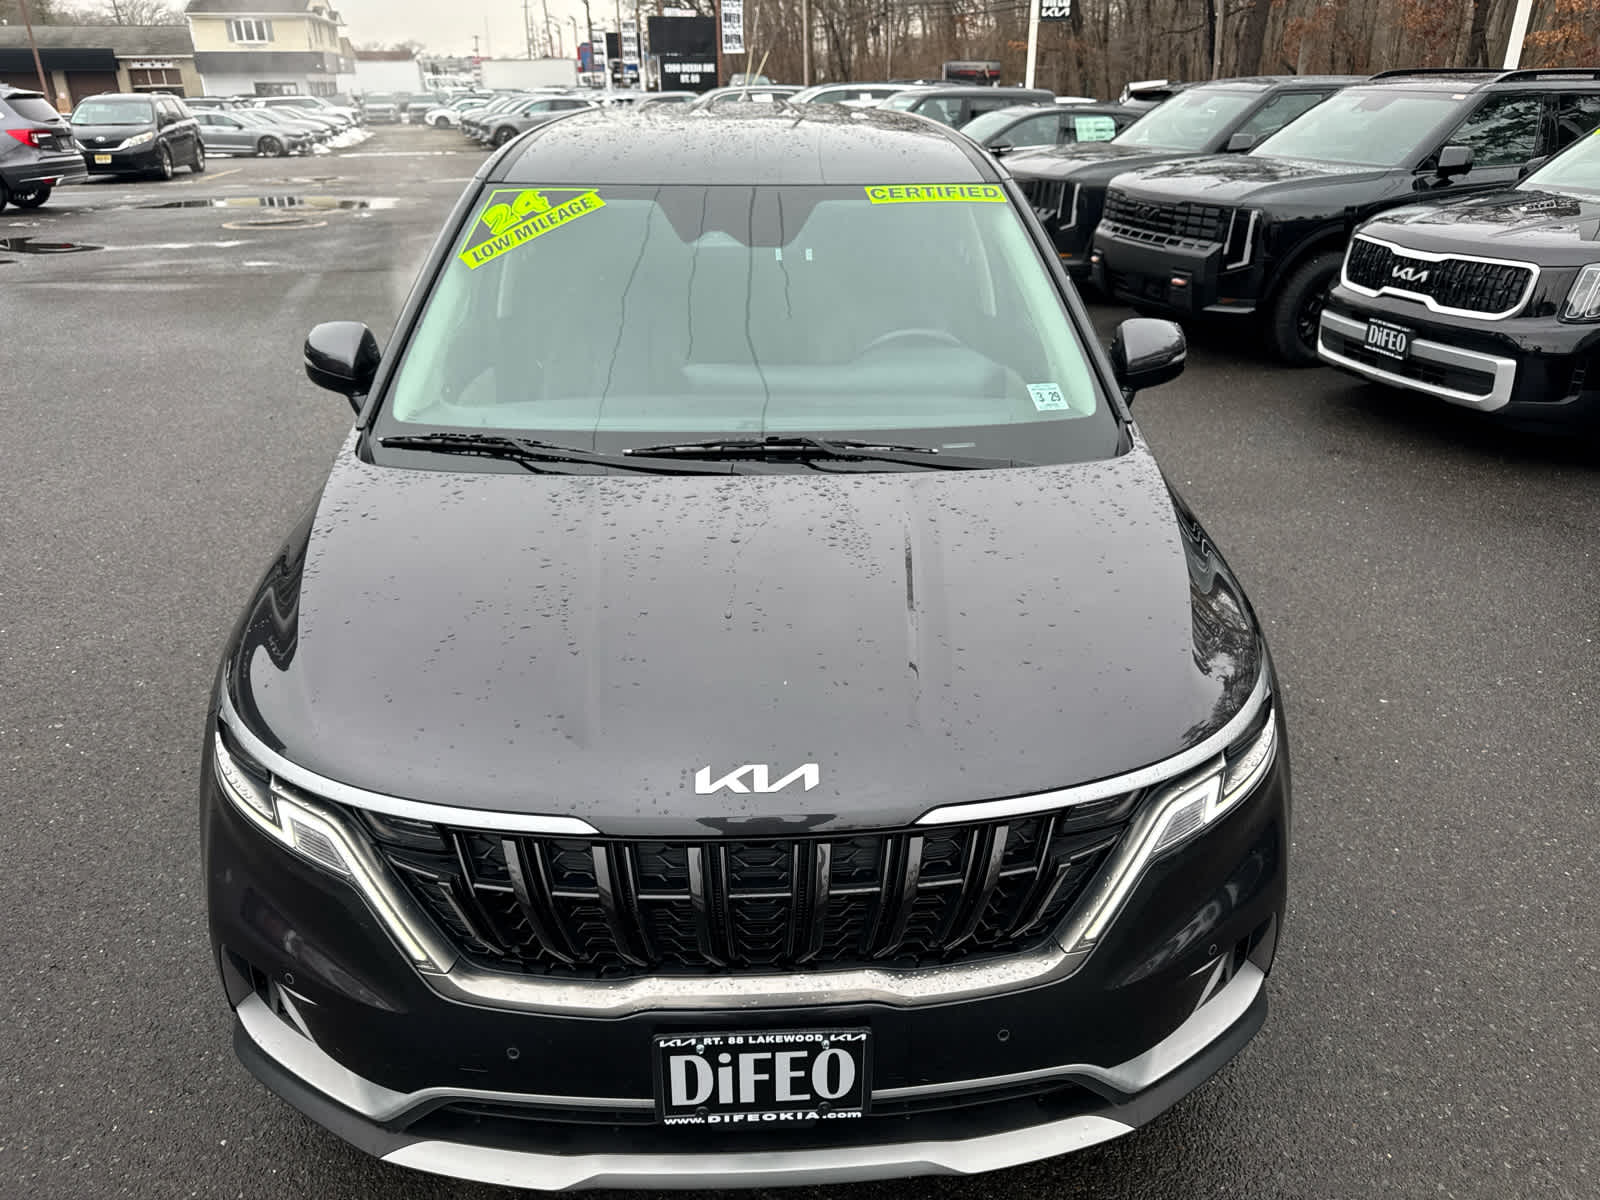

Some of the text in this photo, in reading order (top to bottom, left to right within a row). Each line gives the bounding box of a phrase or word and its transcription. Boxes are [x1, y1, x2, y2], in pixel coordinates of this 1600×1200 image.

[1041, 7, 1070, 17] KIA
[870, 186, 999, 199] CERTIFIED
[481, 190, 552, 236] 24
[471, 196, 593, 263] LOW MILEAGE
[1392, 265, 1430, 283] KIA
[1368, 325, 1406, 353] DiFEO
[1048, 391, 1061, 402] 29
[695, 763, 819, 794] KIA
[659, 1033, 867, 1048] KIA RT. 88 LAKEWOOD KIA
[669, 1048, 856, 1106] DiFEO
[663, 1111, 862, 1125] www.DIFEOKIA.com
